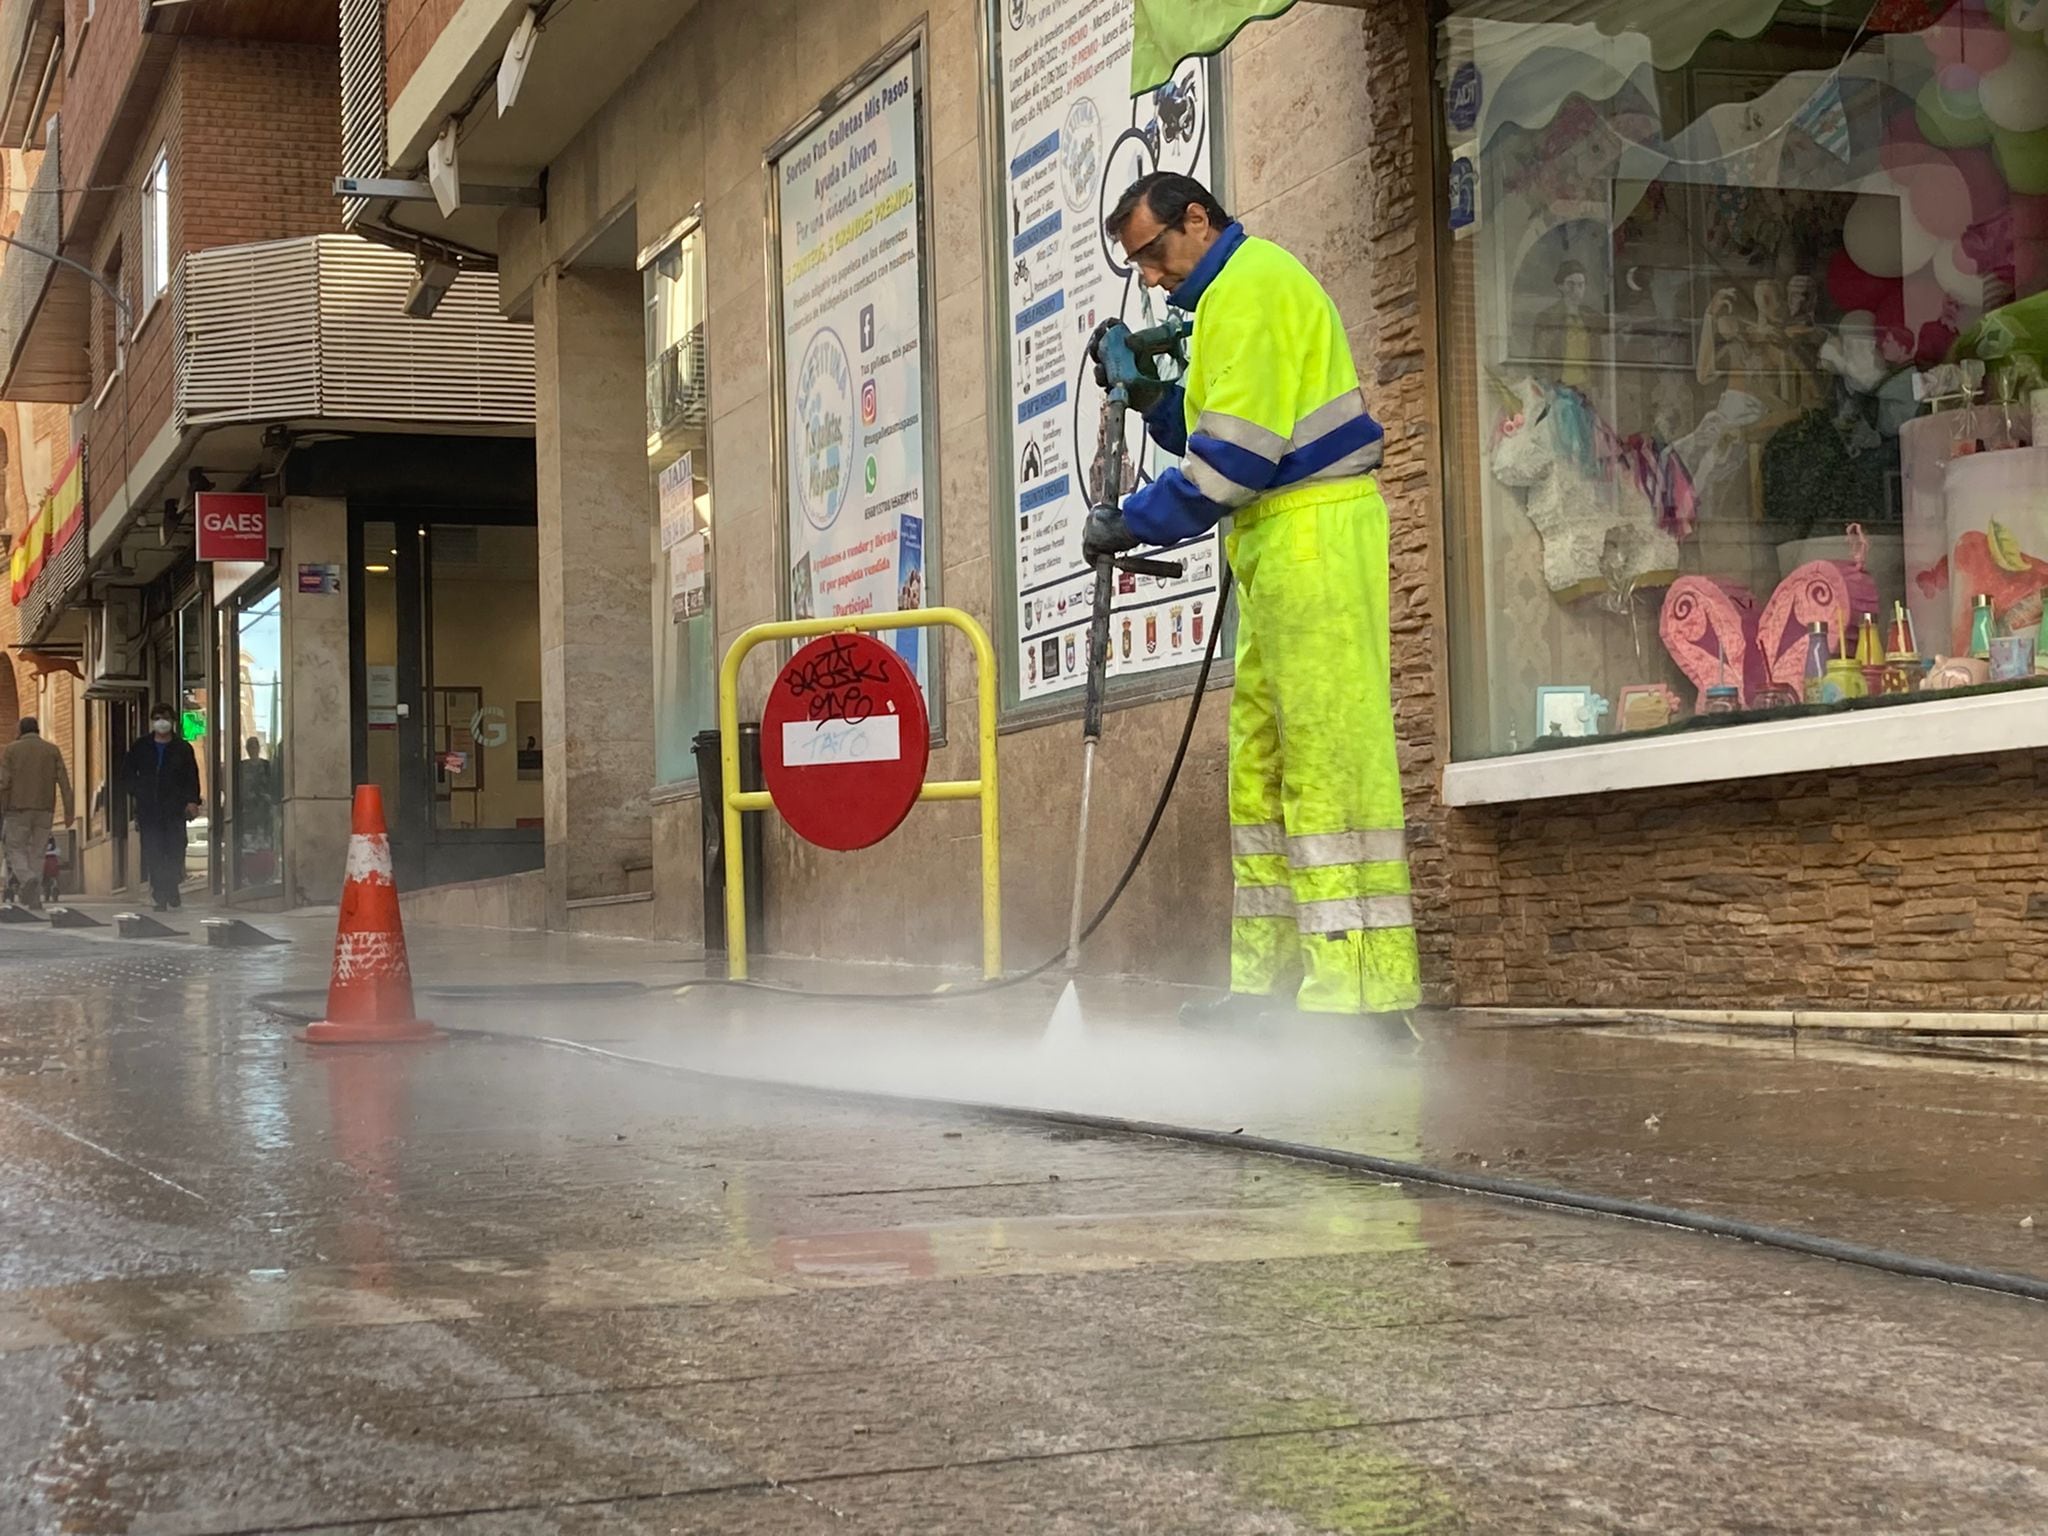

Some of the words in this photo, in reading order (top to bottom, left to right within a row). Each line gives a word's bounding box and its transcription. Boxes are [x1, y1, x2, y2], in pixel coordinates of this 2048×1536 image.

[786, 153, 812, 185] Sorteo
[812, 139, 827, 163] Tus
[828, 111, 863, 151] Galletas
[864, 96, 880, 123] Mis
[881, 75, 909, 111] Pasos
[815, 163, 841, 201] Ayuda
[849, 137, 877, 174] Álvaro
[859, 156, 898, 199] adaptada
[203, 513, 263, 531] GAES
[832, 591, 873, 618] ¡Participa!
